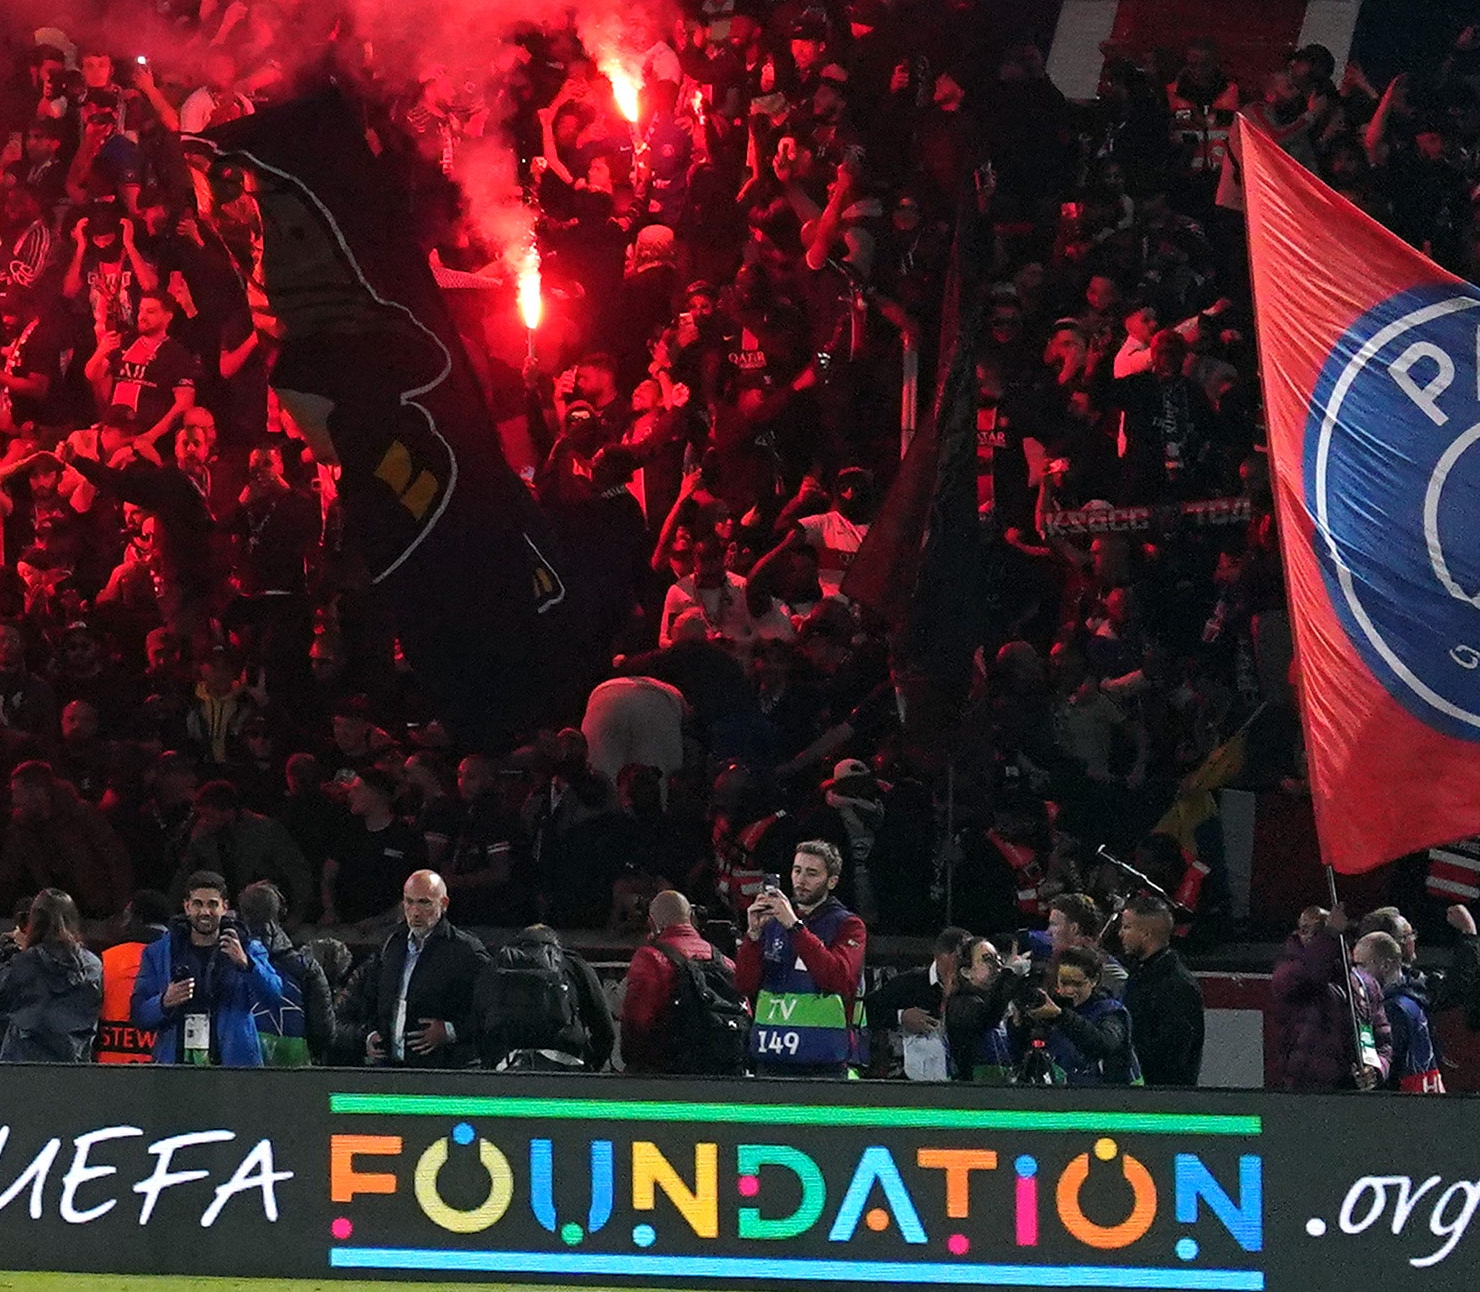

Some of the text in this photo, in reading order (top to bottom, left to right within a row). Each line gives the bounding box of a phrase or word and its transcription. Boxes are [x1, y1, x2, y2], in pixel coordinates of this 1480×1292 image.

[727, 350, 765, 365] QATAR
[977, 431, 1006, 444] ATAR
[765, 999, 797, 1021] TV
[102, 1026, 158, 1049] STEW
[758, 1029, 800, 1055] 149
[328, 1125, 1263, 1261] FOUNDATION
[1305, 1173, 1480, 1268] .org
